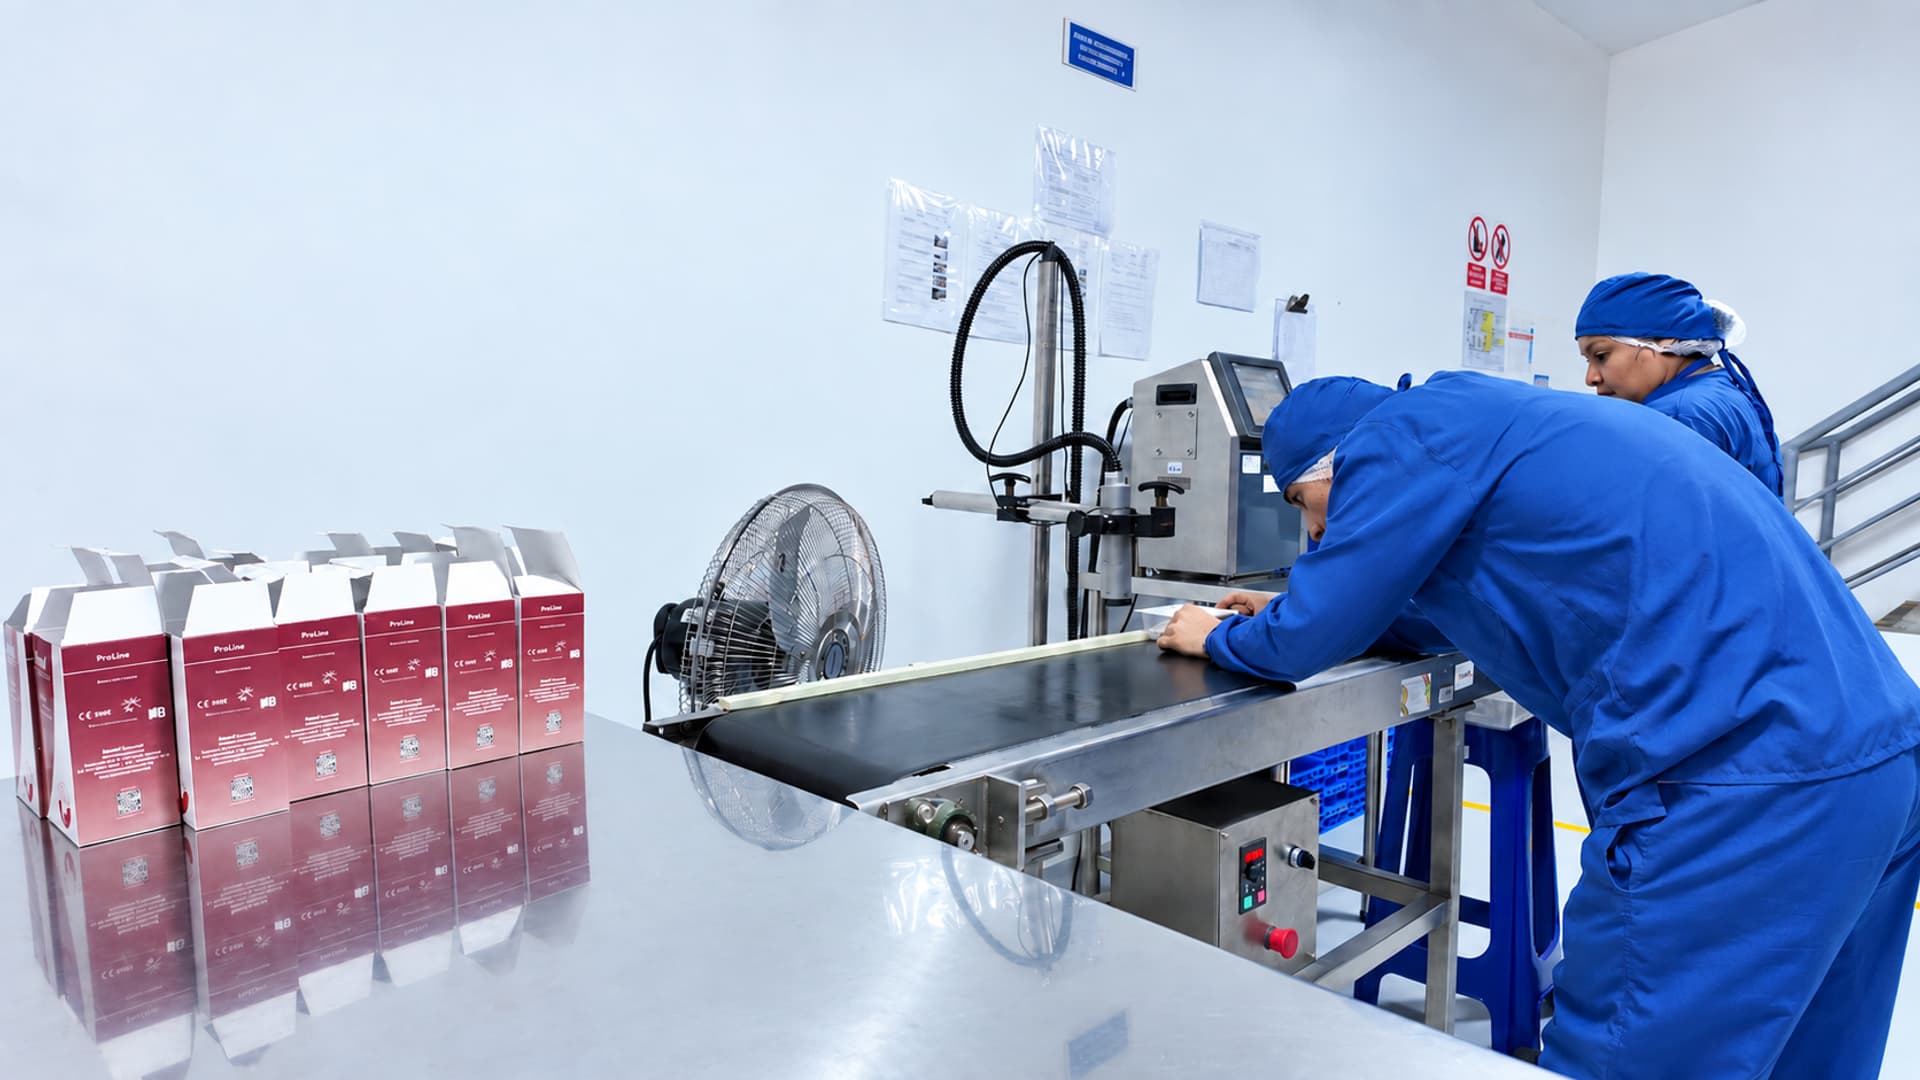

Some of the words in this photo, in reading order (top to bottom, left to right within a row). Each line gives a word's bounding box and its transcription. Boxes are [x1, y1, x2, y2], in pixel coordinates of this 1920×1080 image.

[468, 612, 491, 621] ProLine
[389, 619, 415, 628] ProLine
[301, 629, 329, 639] ProLine
[214, 643, 245, 654] ProLine
[97, 651, 130, 662] ProLine
